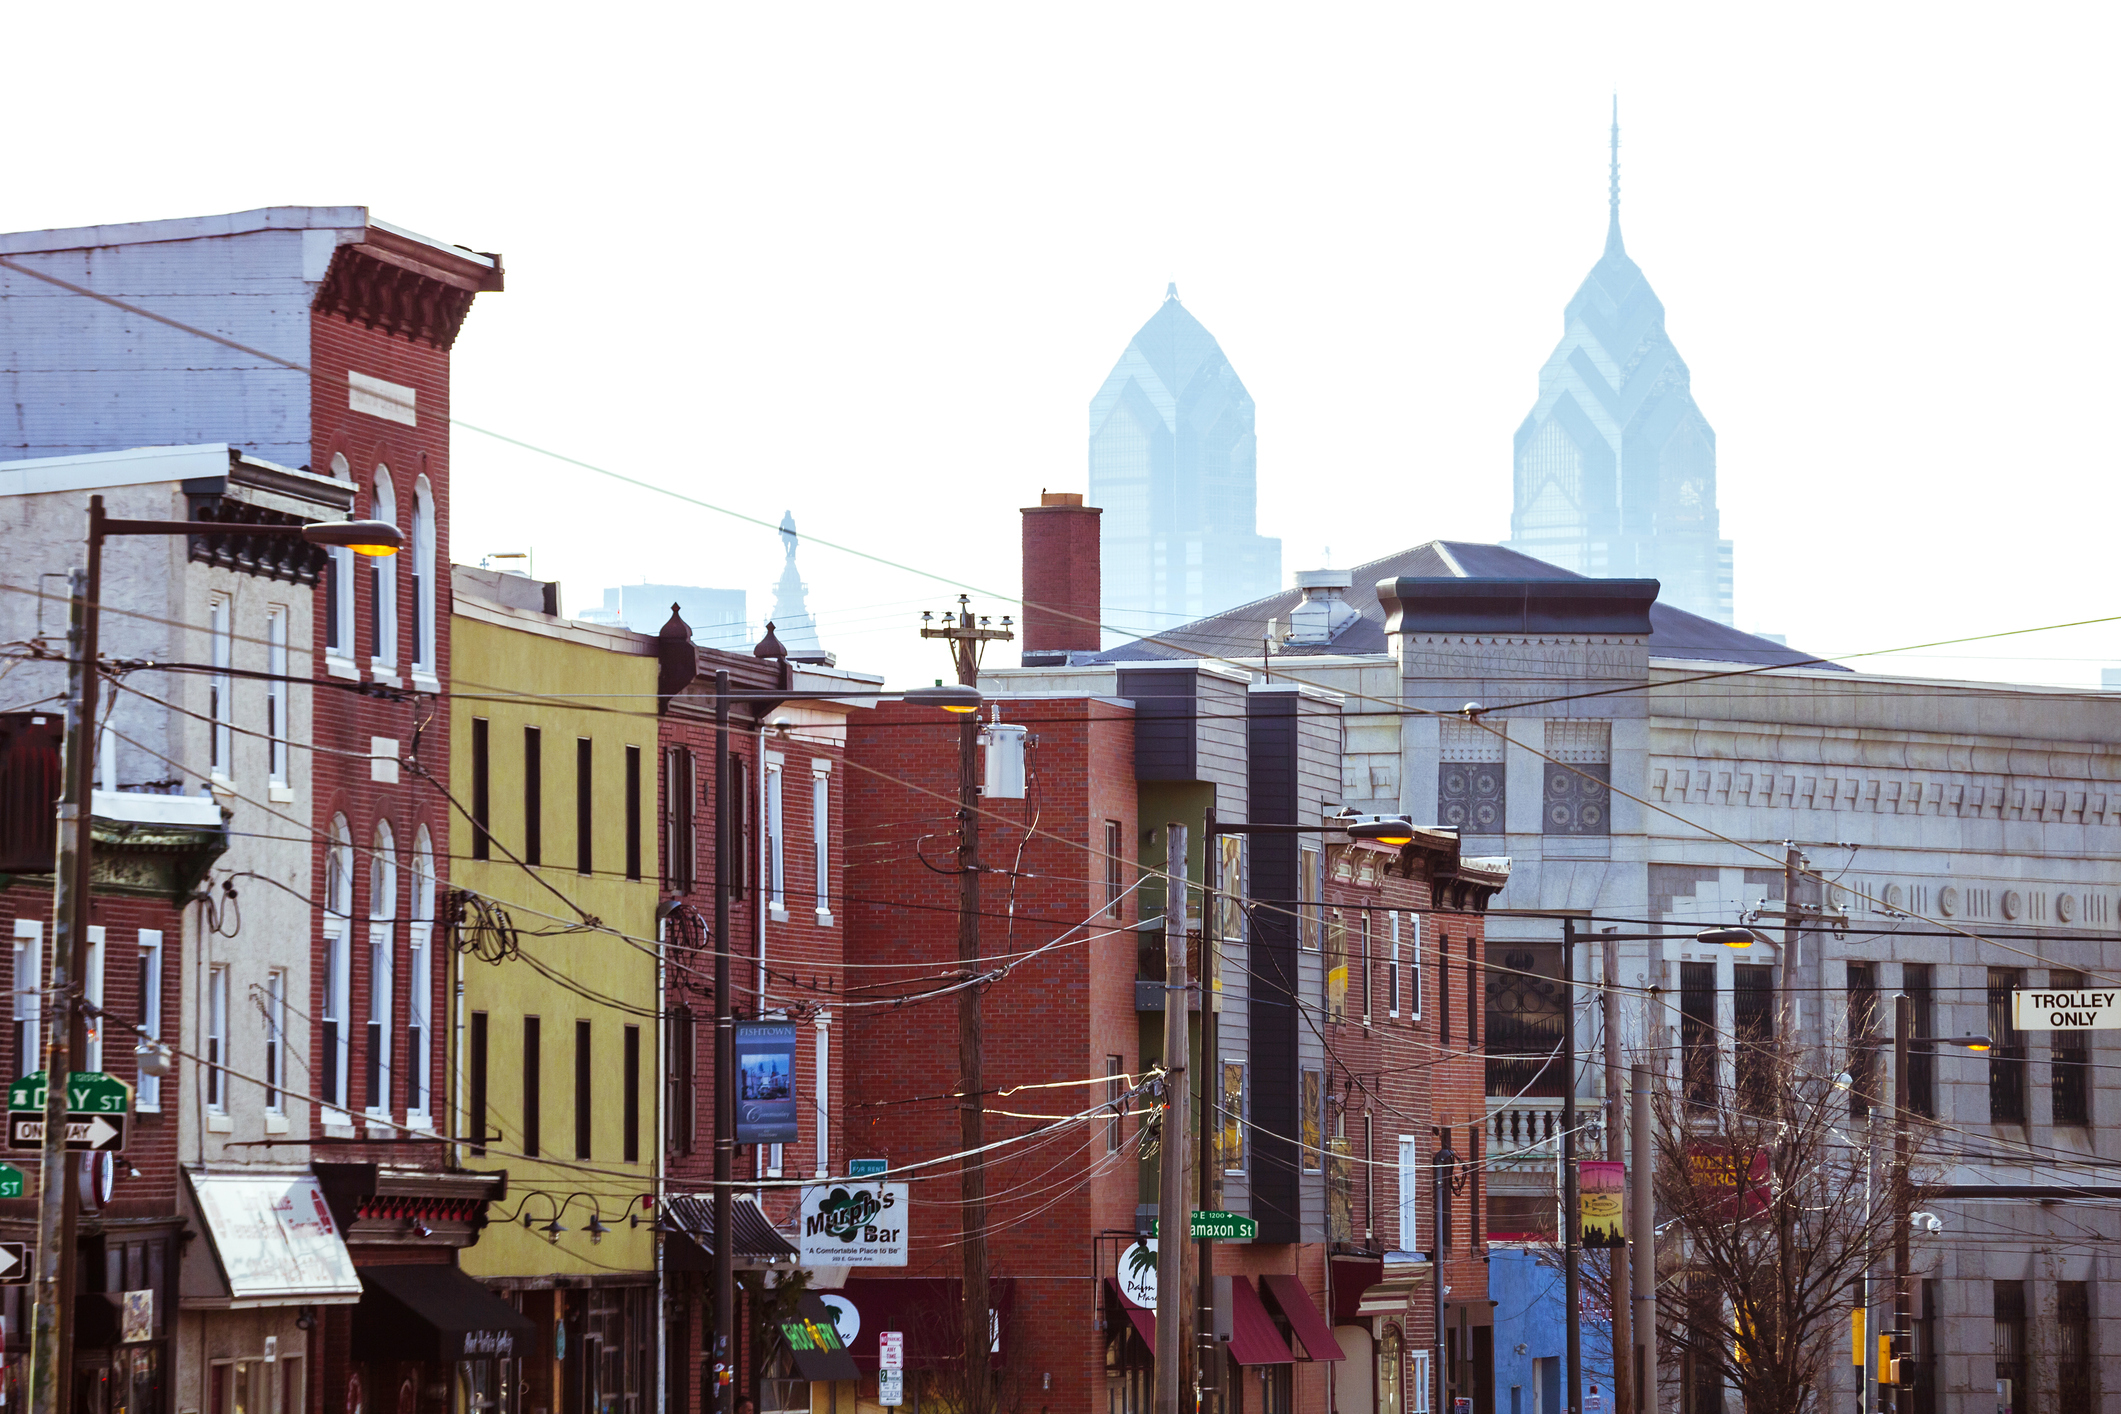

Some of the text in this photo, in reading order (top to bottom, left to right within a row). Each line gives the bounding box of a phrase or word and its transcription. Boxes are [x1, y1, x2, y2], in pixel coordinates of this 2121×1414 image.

[1409, 648, 1643, 676] KENSINGTON NATIONAL
[1498, 687, 1556, 717] BANK
[2031, 993, 2115, 1009] TROLLEY
[2050, 1011, 2097, 1026] ONLY
[740, 1027, 792, 1036] FISHTOWN
[33, 1087, 124, 1110] DY ST
[21, 1123, 43, 1138] ON
[1692, 1172, 1752, 1187] FARG
[1, 1181, 20, 1196] ST
[807, 1190, 895, 1238] Murph's
[1200, 1211, 1206, 1220] E
[863, 1224, 900, 1243] Bar
[1240, 1224, 1253, 1237] St
[816, 1247, 858, 1255] Comfortable
[881, 1370, 886, 1381] 2
